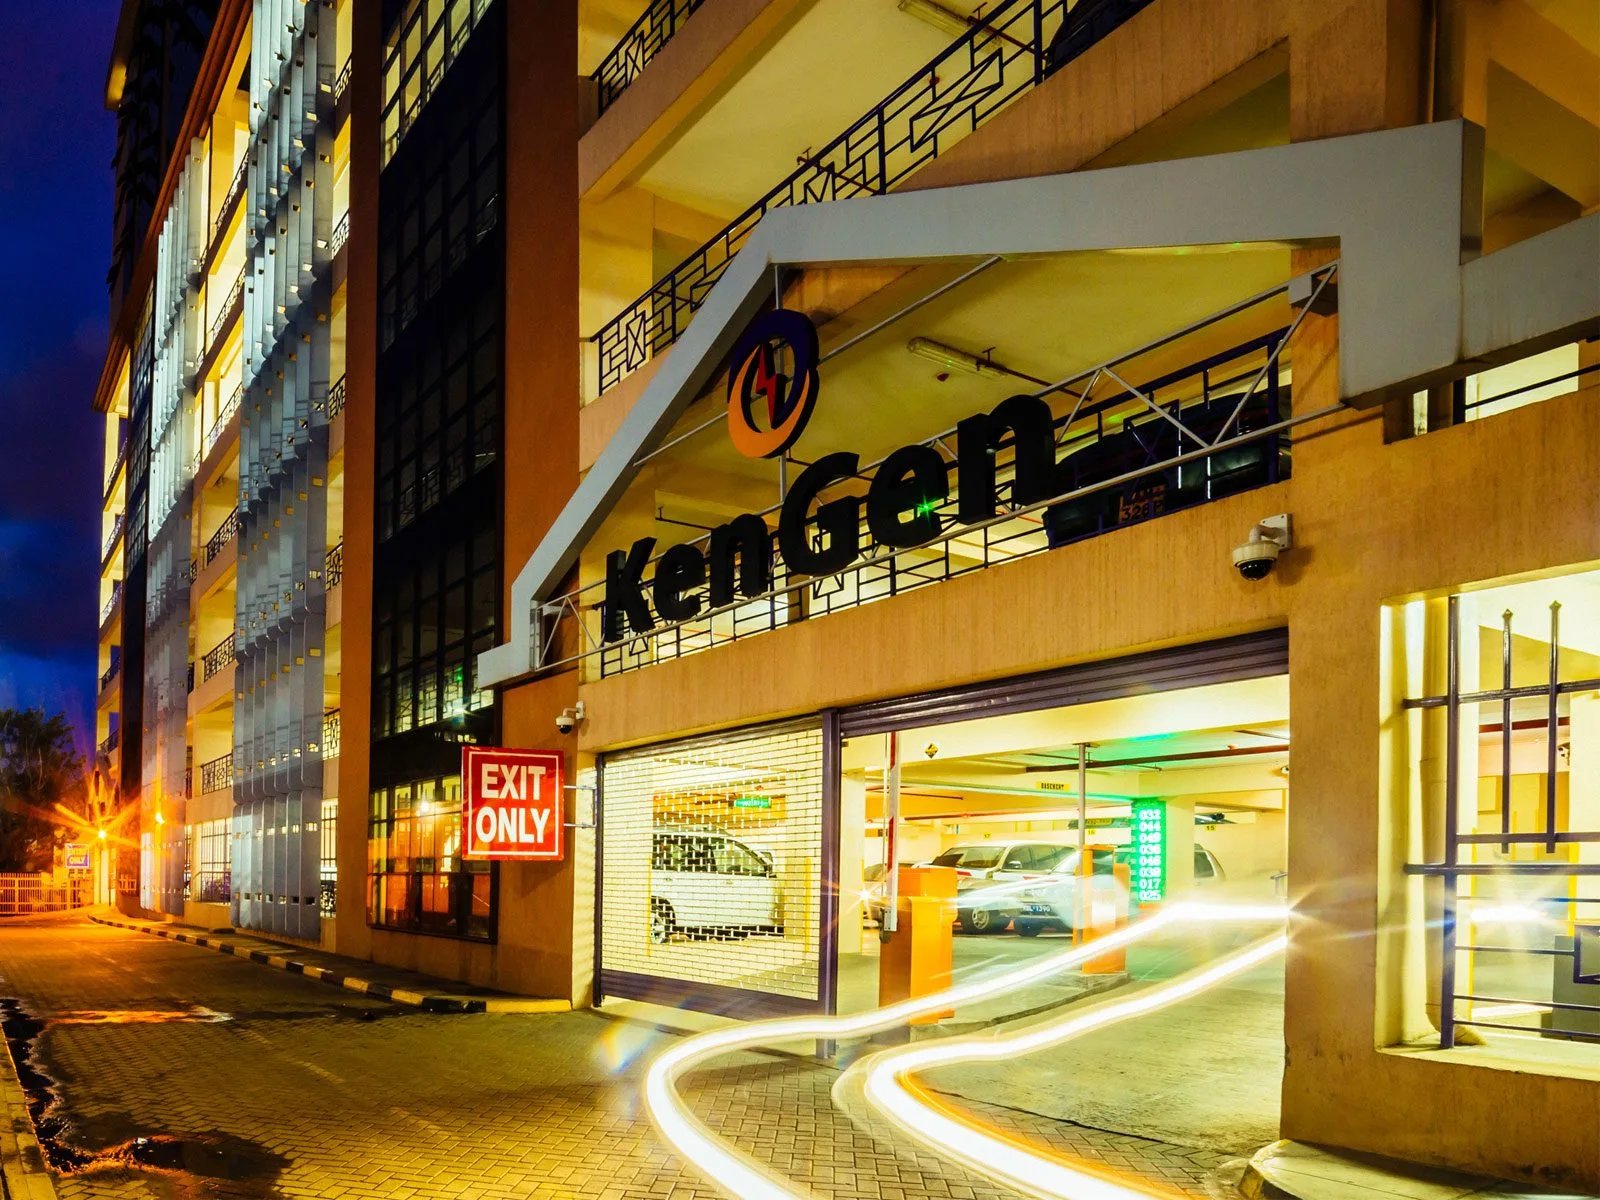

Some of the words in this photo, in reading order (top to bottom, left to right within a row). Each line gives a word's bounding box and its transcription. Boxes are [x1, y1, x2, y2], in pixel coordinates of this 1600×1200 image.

[604, 394, 1056, 643] KenGen
[481, 763, 546, 800] EXIT
[475, 806, 551, 843] ONLY
[1139, 879, 1161, 889] 017
